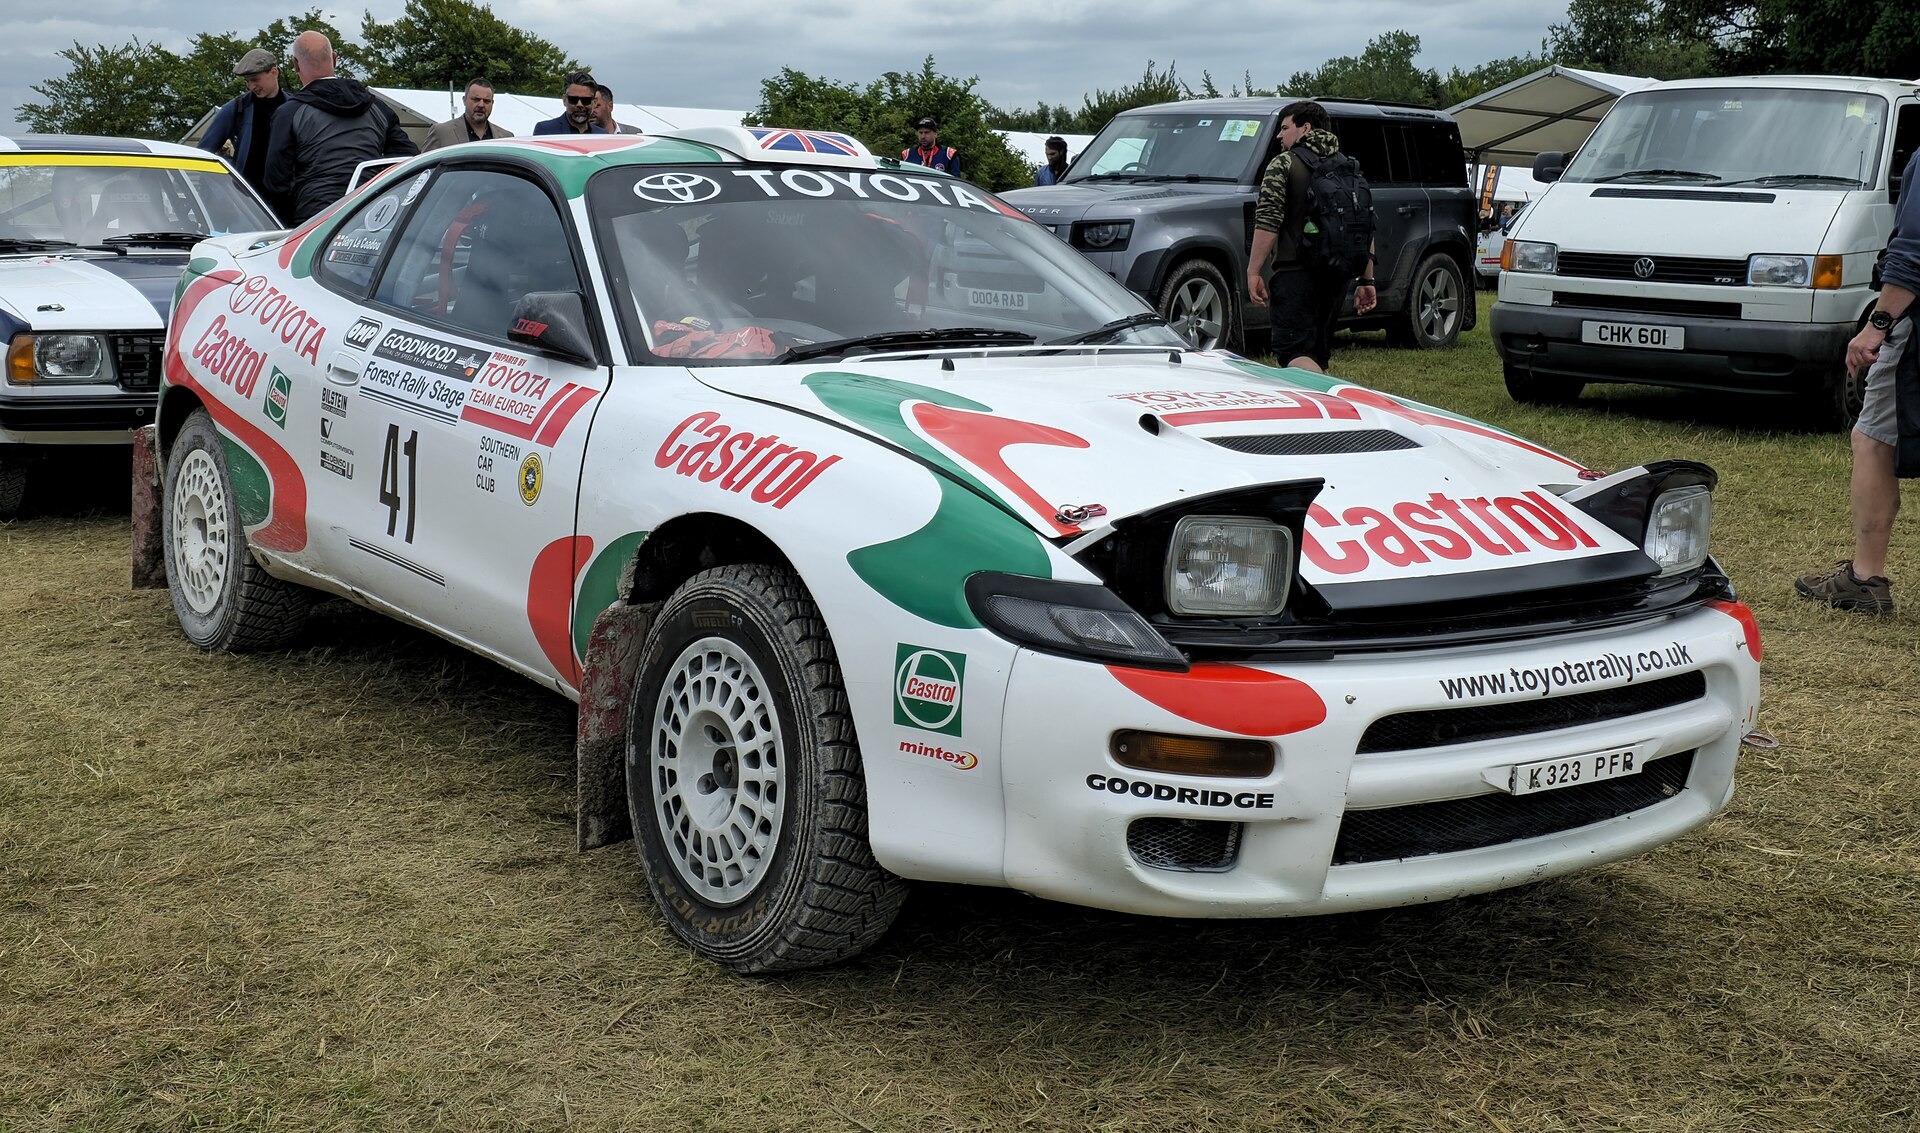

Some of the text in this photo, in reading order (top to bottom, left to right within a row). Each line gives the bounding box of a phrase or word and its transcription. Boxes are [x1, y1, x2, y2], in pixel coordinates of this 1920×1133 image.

[731, 169, 1001, 214] TOYOTA
[374, 203, 391, 223] 41
[1002, 292, 1024, 307] RAB
[250, 286, 327, 367] TOYOTA
[1598, 324, 1667, 346] CHK 601
[192, 314, 268, 401] Castrol
[382, 333, 458, 364] GOODWOOD
[491, 351, 528, 367] PREPARED BY
[362, 360, 466, 409] Forest Rally Stage
[478, 362, 552, 401] TOYOTA
[321, 386, 349, 411] BILSTEIN
[468, 388, 537, 419] TEAM EUROPE
[1116, 390, 1272, 405] TOYOTA
[1145, 398, 1297, 412] TEAM EUROPE
[477, 455, 493, 472] CAR
[480, 436, 520, 461] SOUTHERN
[654, 411, 844, 510] Castrol
[379, 423, 418, 544] 41
[476, 473, 495, 493] CLUB
[1302, 491, 1601, 575] Castrol
[1438, 641, 1693, 700] www.toyotarally.co.uk
[906, 677, 957, 703] Castrol
[899, 740, 968, 766] mintex
[1529, 751, 1634, 790] K323 PFR
[1085, 773, 1275, 809] GOODRIDGE
